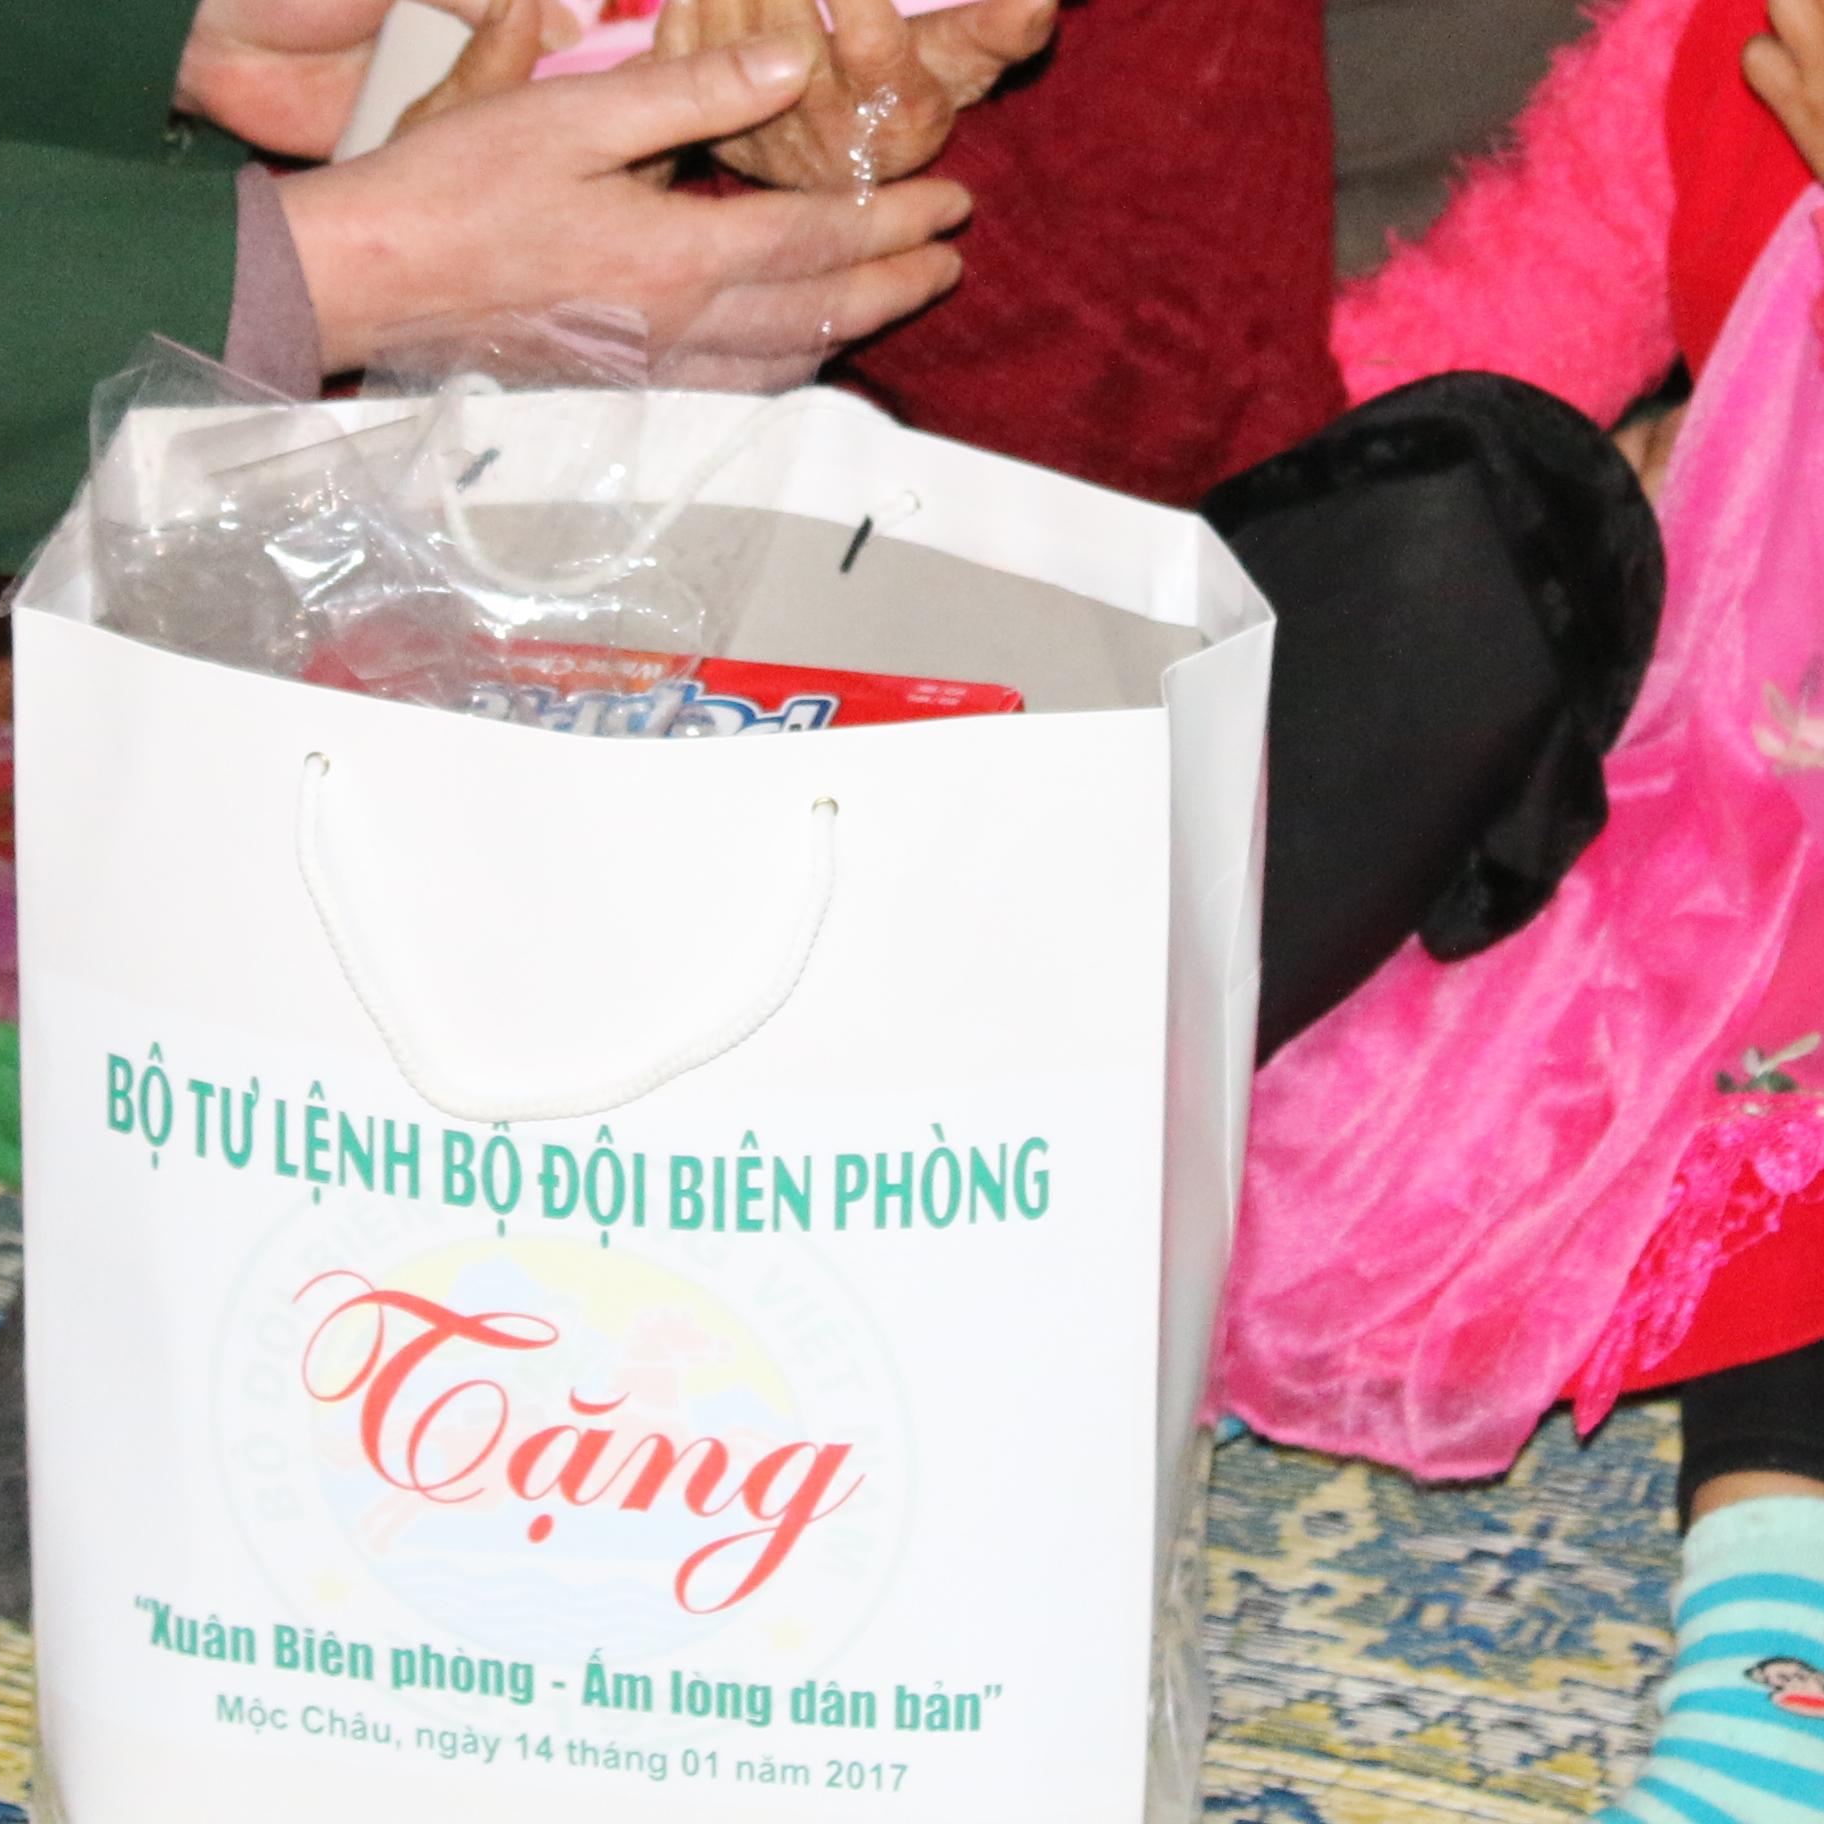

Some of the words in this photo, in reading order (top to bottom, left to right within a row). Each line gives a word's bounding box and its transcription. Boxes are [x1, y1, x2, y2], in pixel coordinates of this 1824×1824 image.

[108, 1041, 174, 1170] BỘ
[187, 1075, 259, 1169] TƯ
[275, 1079, 421, 1206] LỆNH
[443, 1123, 522, 1236] BỘ
[537, 1125, 646, 1247] ĐỘI
[670, 1129, 813, 1232] BIÊN
[834, 1122, 1050, 1230] PHÒNG
[292, 1269, 867, 1614] Tặng
[216, 1693, 290, 1736] Mộc
[301, 1705, 403, 1750] Châu,
[415, 1724, 502, 1765] ngày
[515, 1733, 556, 1764] 14
[565, 1739, 669, 1782] tháng
[680, 1747, 719, 1780] 01
[735, 1754, 812, 1786] năm
[824, 1759, 910, 1794] 2017
[273, 1623, 376, 1682] Biên
[389, 1642, 536, 1706] phòng
[581, 1648, 655, 1713] Ấm
[669, 1669, 775, 1729] lòng
[789, 1679, 879, 1730] dân
